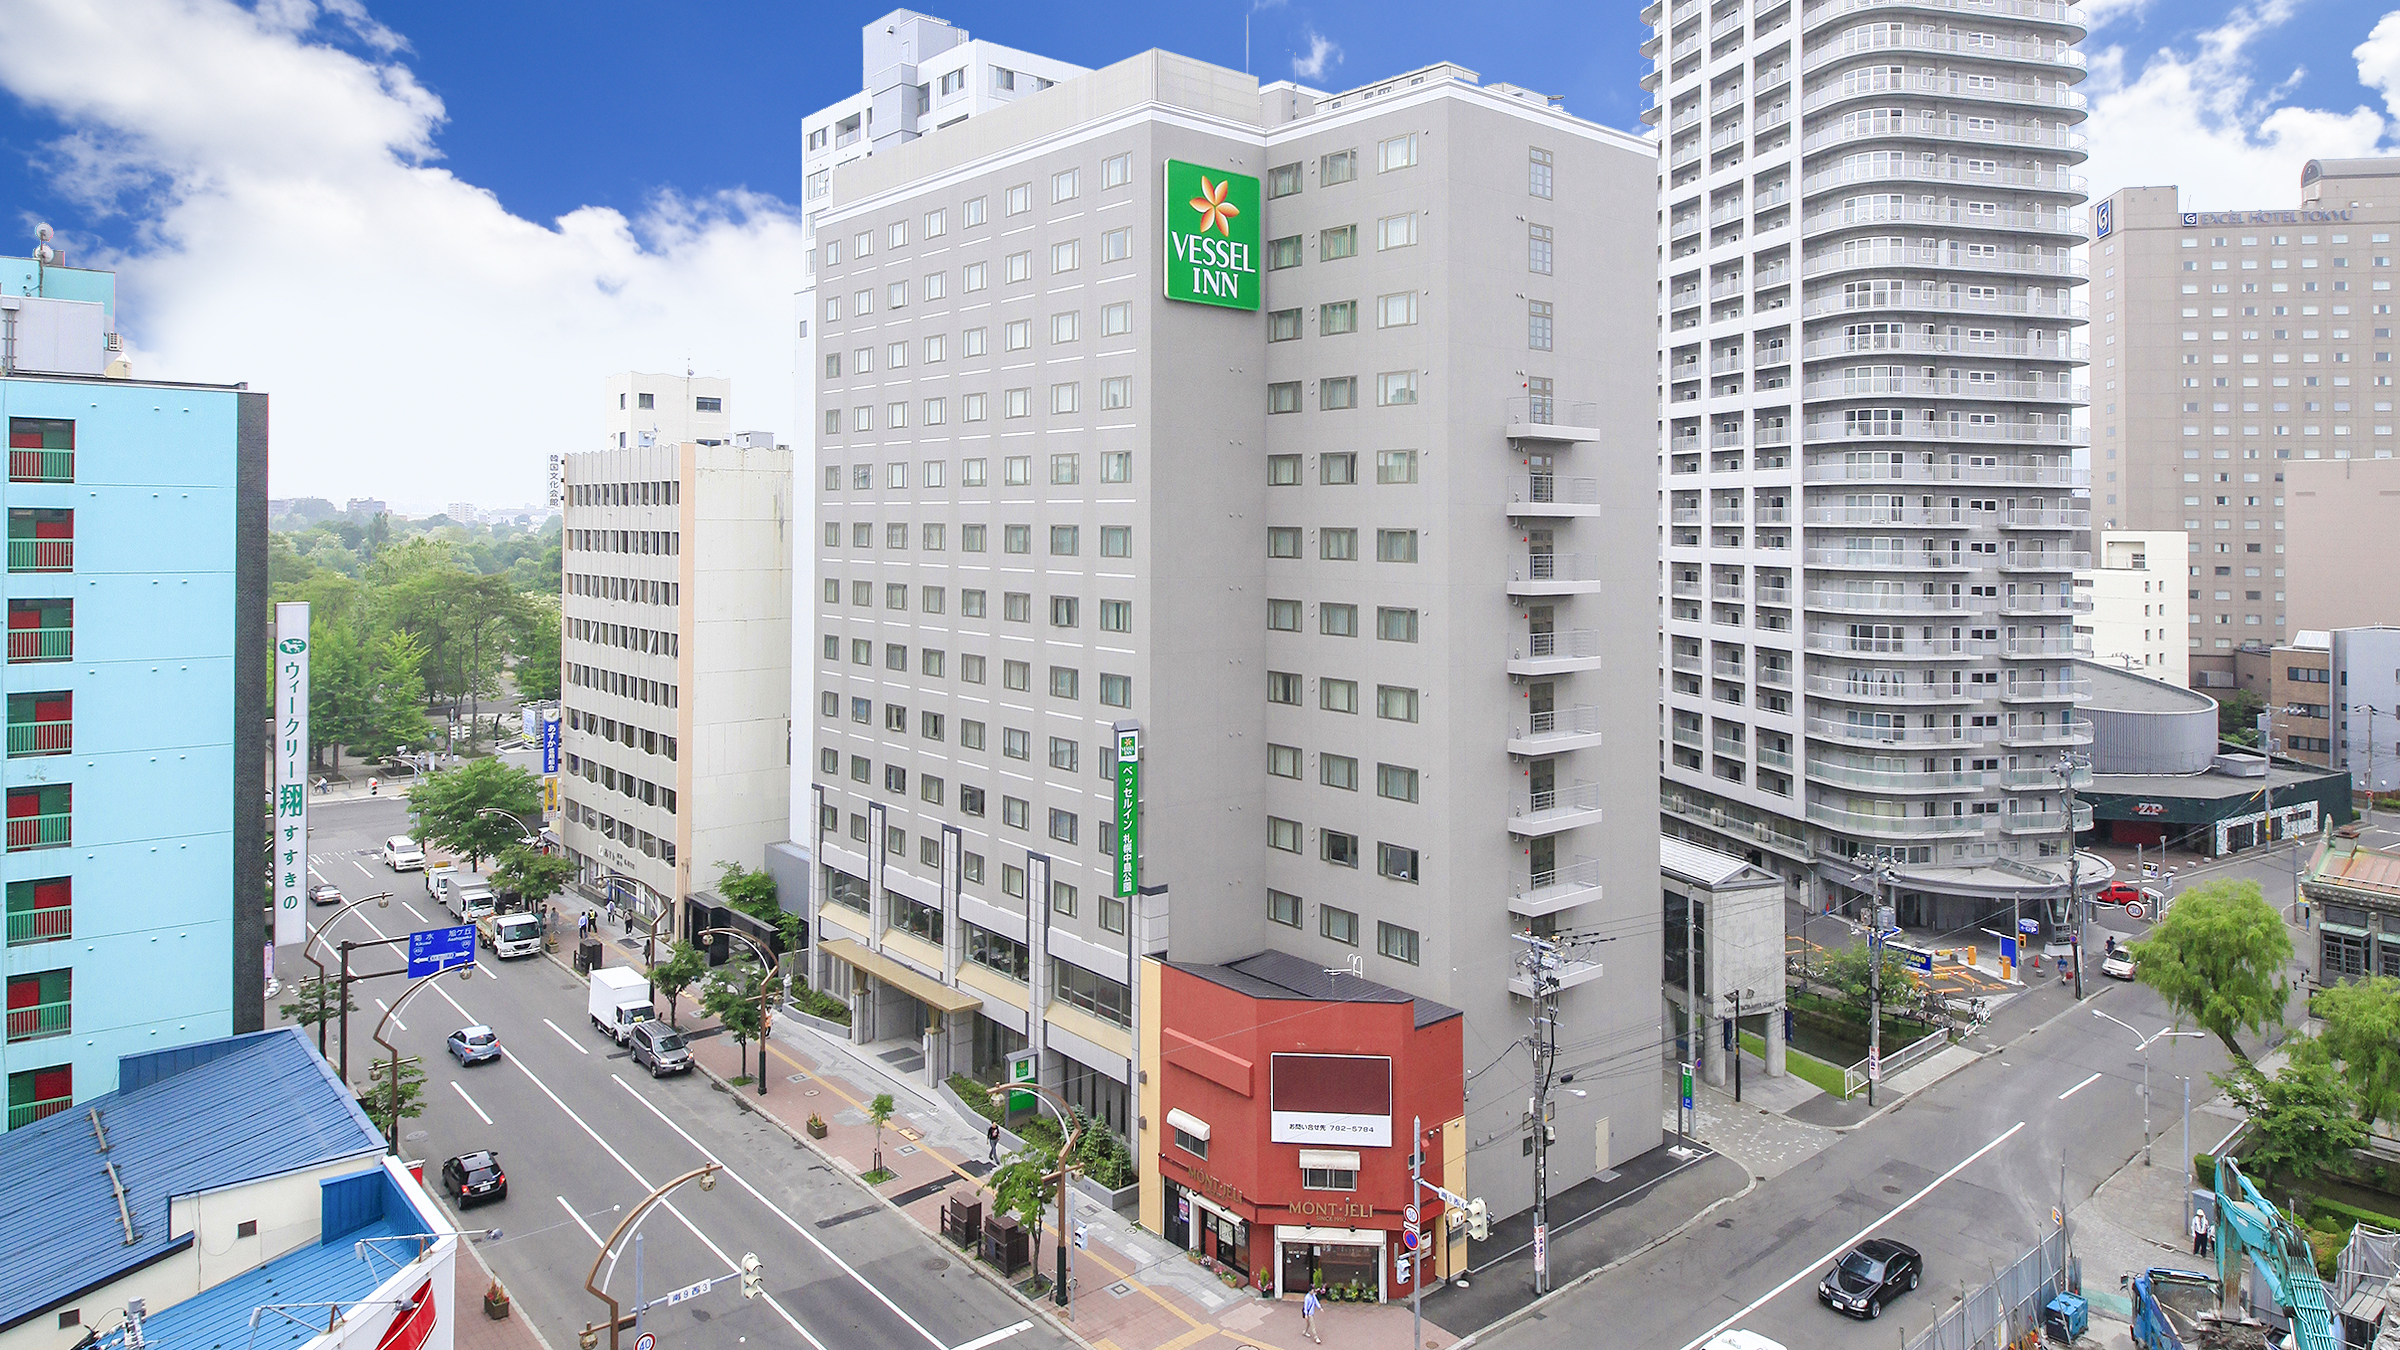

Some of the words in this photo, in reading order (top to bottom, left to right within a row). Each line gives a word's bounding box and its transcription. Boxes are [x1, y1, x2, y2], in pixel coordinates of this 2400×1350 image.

[2202, 212, 2244, 225] EXCEL
[2249, 211, 2297, 223] HOTEL
[2301, 209, 2353, 222] TOKYU
[1171, 230, 1256, 273] VESSEL
[1193, 266, 1239, 299] INN
[2130, 906, 2140, 915] 30
[1329, 1125, 1375, 1133] 782-5784
[1407, 1209, 1417, 1222] 30
